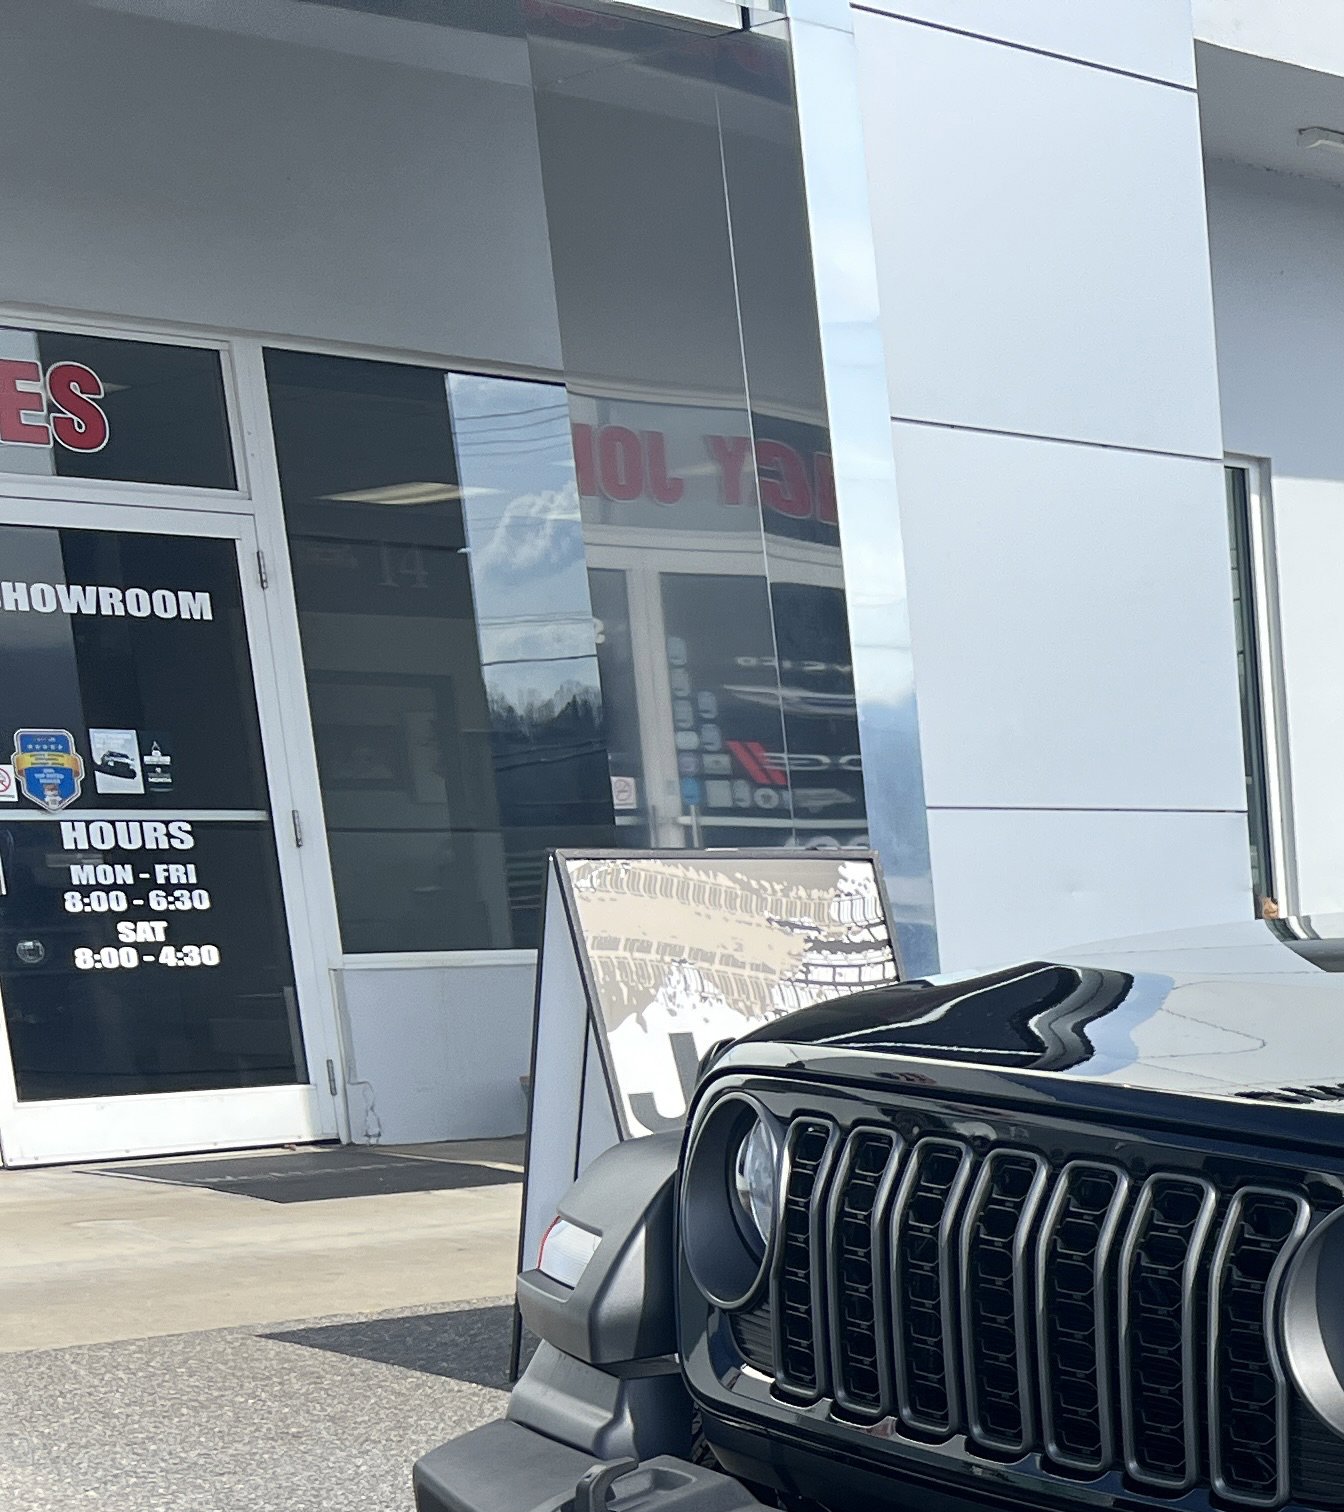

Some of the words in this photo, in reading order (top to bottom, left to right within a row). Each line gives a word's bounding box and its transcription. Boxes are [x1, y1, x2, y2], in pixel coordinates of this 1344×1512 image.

[0, 359, 109, 453] ES
[0, 581, 213, 621] HOWROOM
[60, 821, 195, 850] HOURS
[70, 864, 134, 885] MON
[154, 864, 198, 885] FRI
[63, 891, 128, 913] 8:00
[149, 889, 211, 910] 6:30
[116, 920, 168, 942] SAT
[73, 947, 139, 970] 8:00
[159, 944, 220, 967] 4:30
